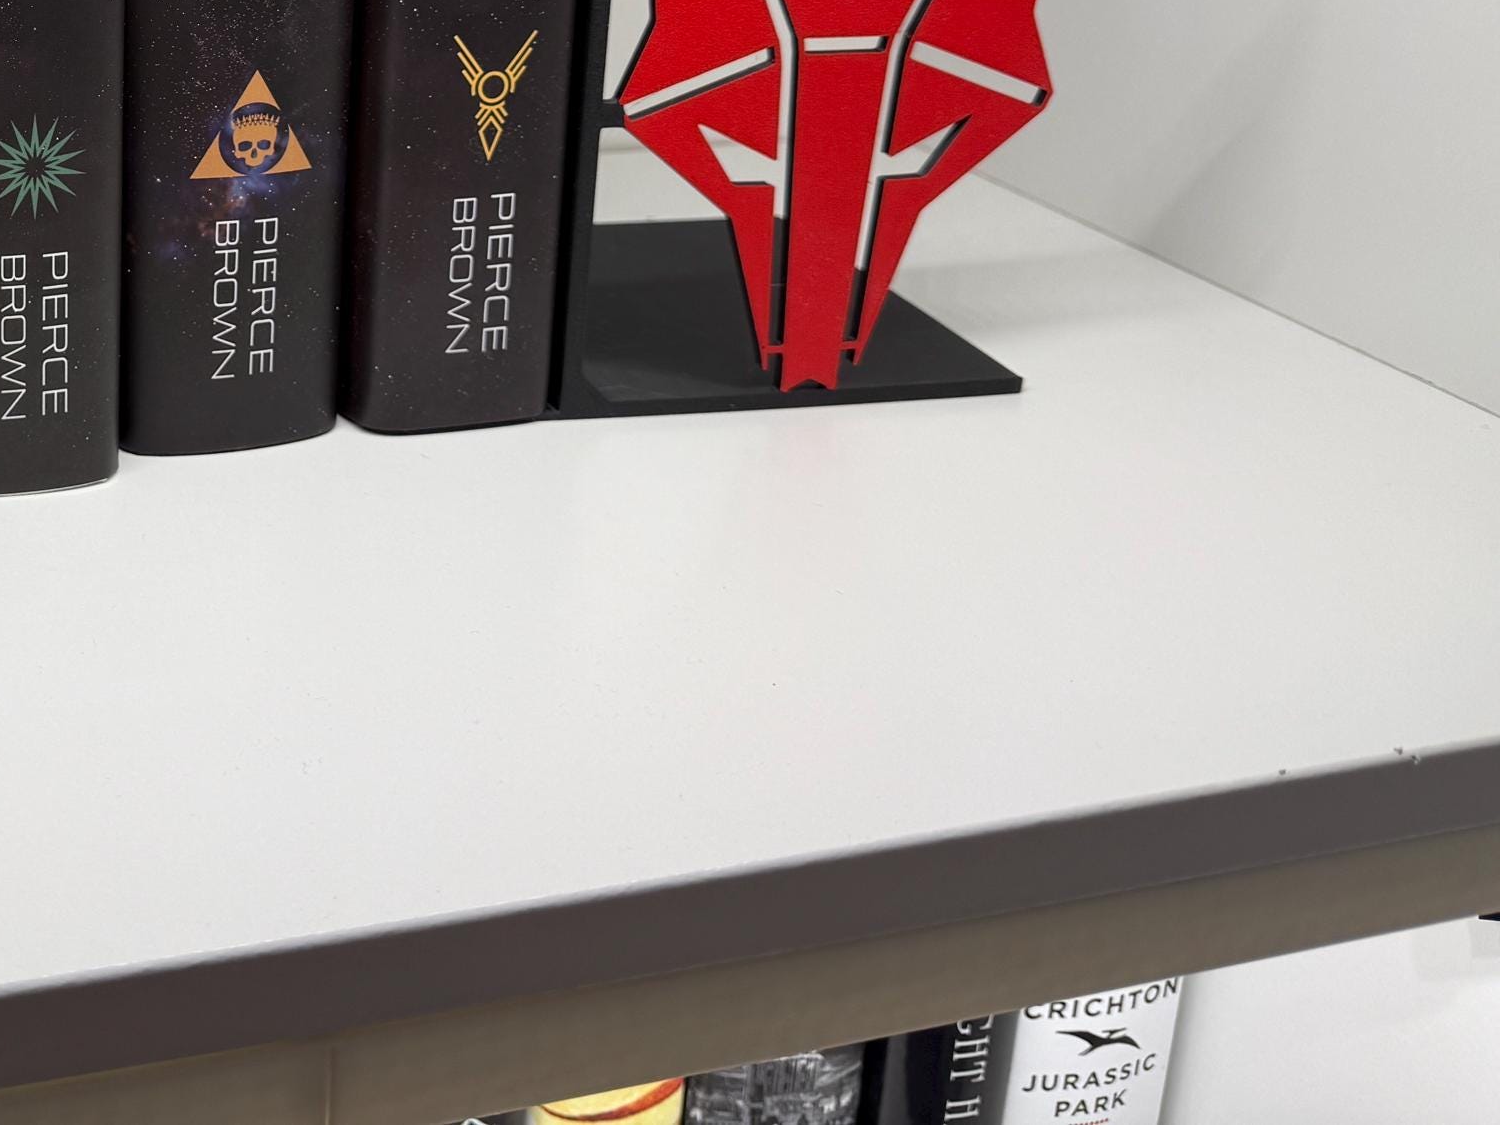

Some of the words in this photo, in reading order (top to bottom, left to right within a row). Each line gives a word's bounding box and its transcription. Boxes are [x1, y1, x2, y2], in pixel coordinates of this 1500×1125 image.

[0, 254, 27, 421] BROWN
[41, 251, 69, 417] PIERCE
[210, 219, 241, 380] BROWN
[248, 216, 280, 376] PIERCE
[444, 196, 478, 355] BROWN
[481, 192, 517, 353] PIERCE
[1022, 1053, 1157, 1092] JURASSIC
[1024, 977, 1178, 1021] CRICHTON
[1054, 1089, 1127, 1117] PARK
